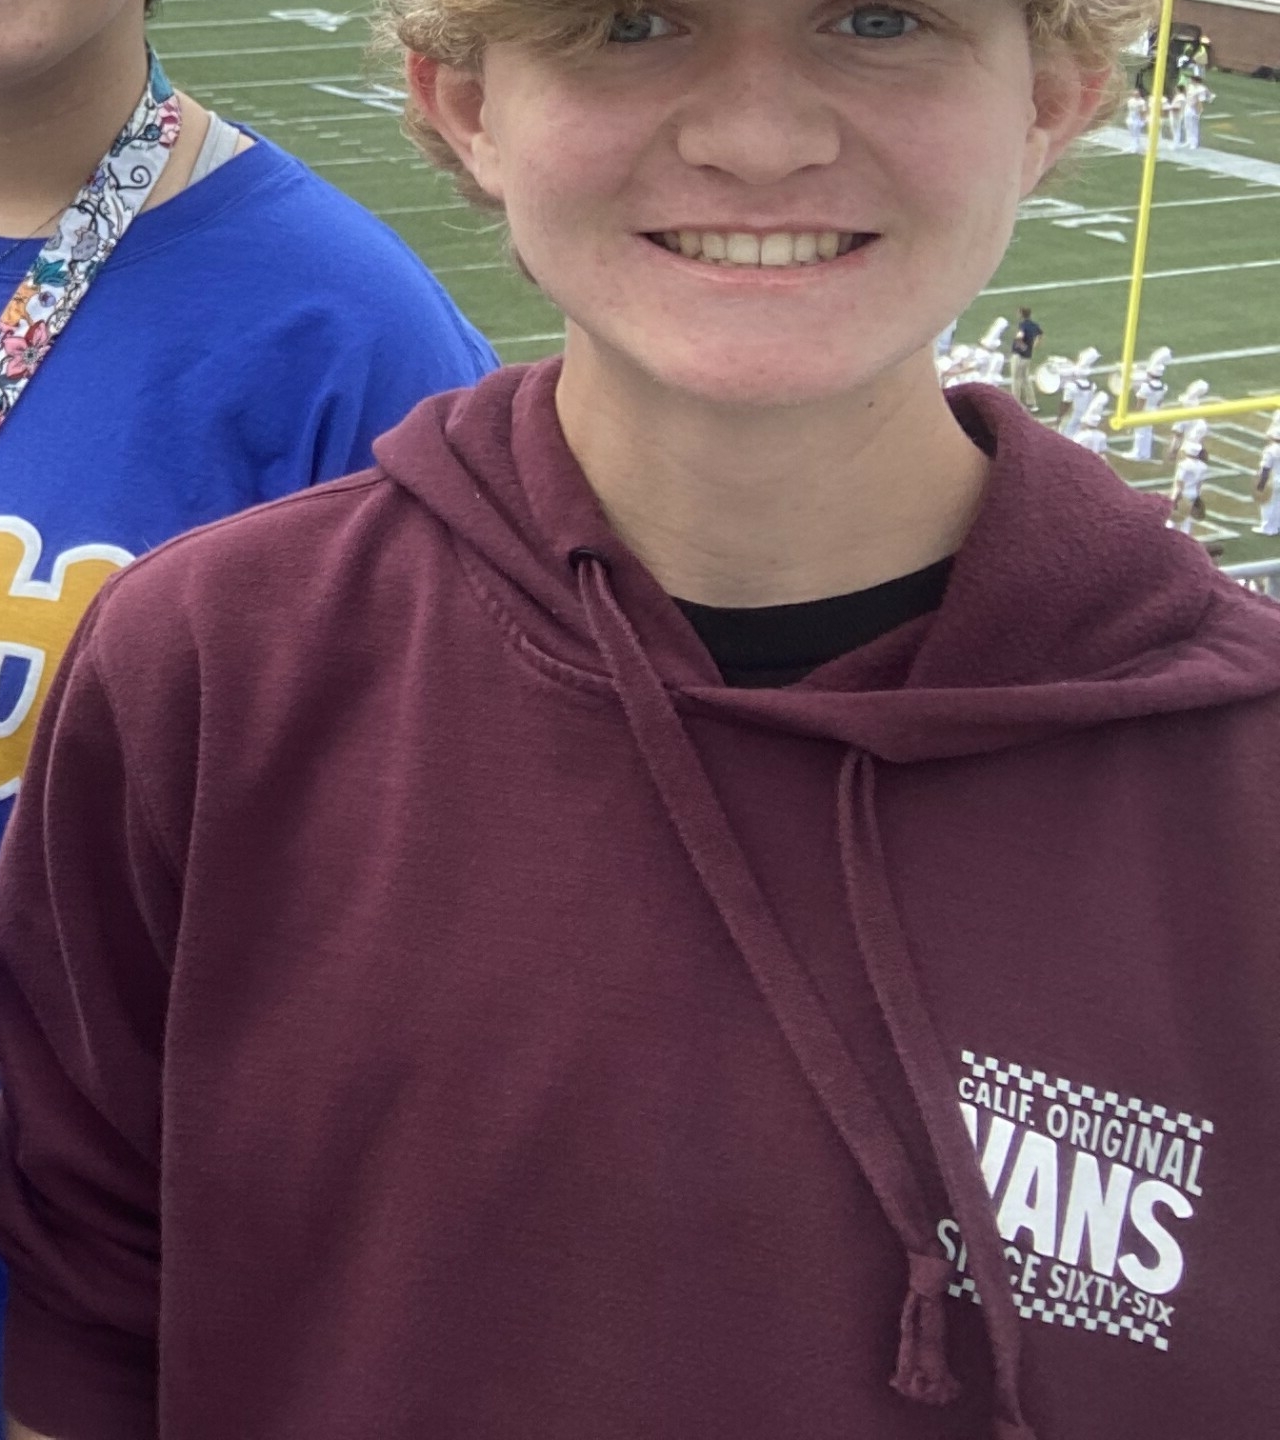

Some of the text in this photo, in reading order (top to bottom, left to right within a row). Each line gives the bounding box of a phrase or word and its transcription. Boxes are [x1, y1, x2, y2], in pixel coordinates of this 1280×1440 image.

[957, 1076, 1203, 1197] CALIF. ORIGINAL
[958, 1101, 1194, 1295] VANS
[1047, 1264, 1176, 1328] SIXTY-SIX
